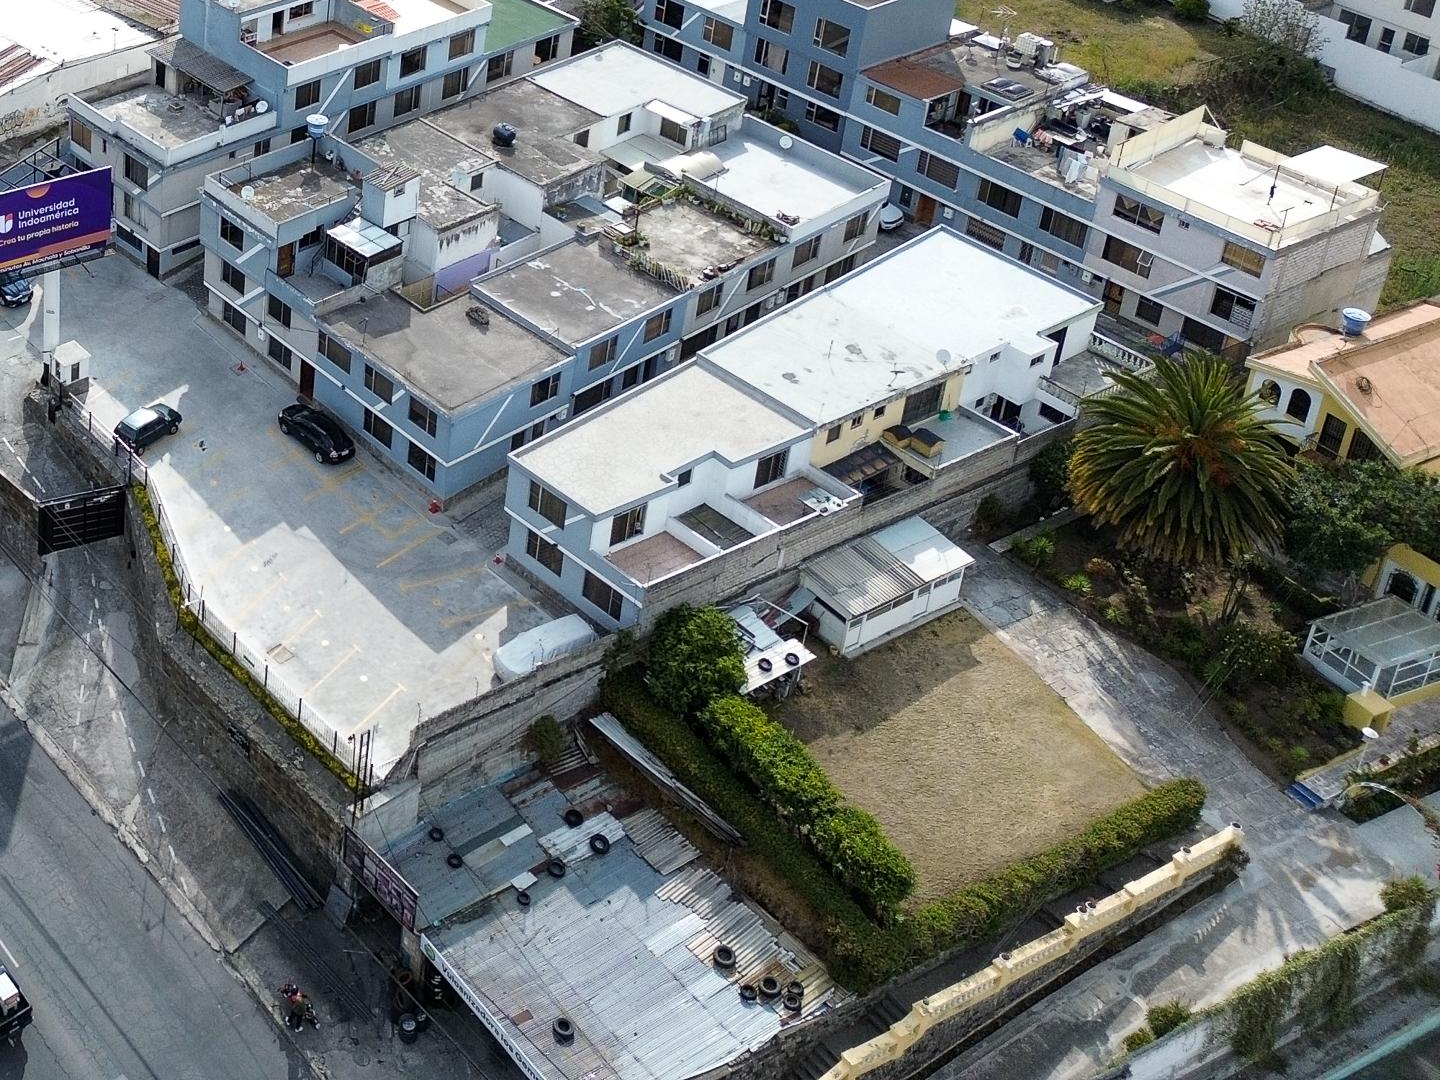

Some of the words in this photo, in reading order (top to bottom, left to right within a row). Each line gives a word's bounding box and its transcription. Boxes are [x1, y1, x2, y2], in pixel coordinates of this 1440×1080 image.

[18, 198, 76, 220] Universidad
[18, 207, 79, 228] Indoamérica
[17, 232, 26, 242] tu
[26, 228, 51, 241] propia
[51, 221, 79, 233] historia
[441, 963, 500, 1036] Vulcanizadora
